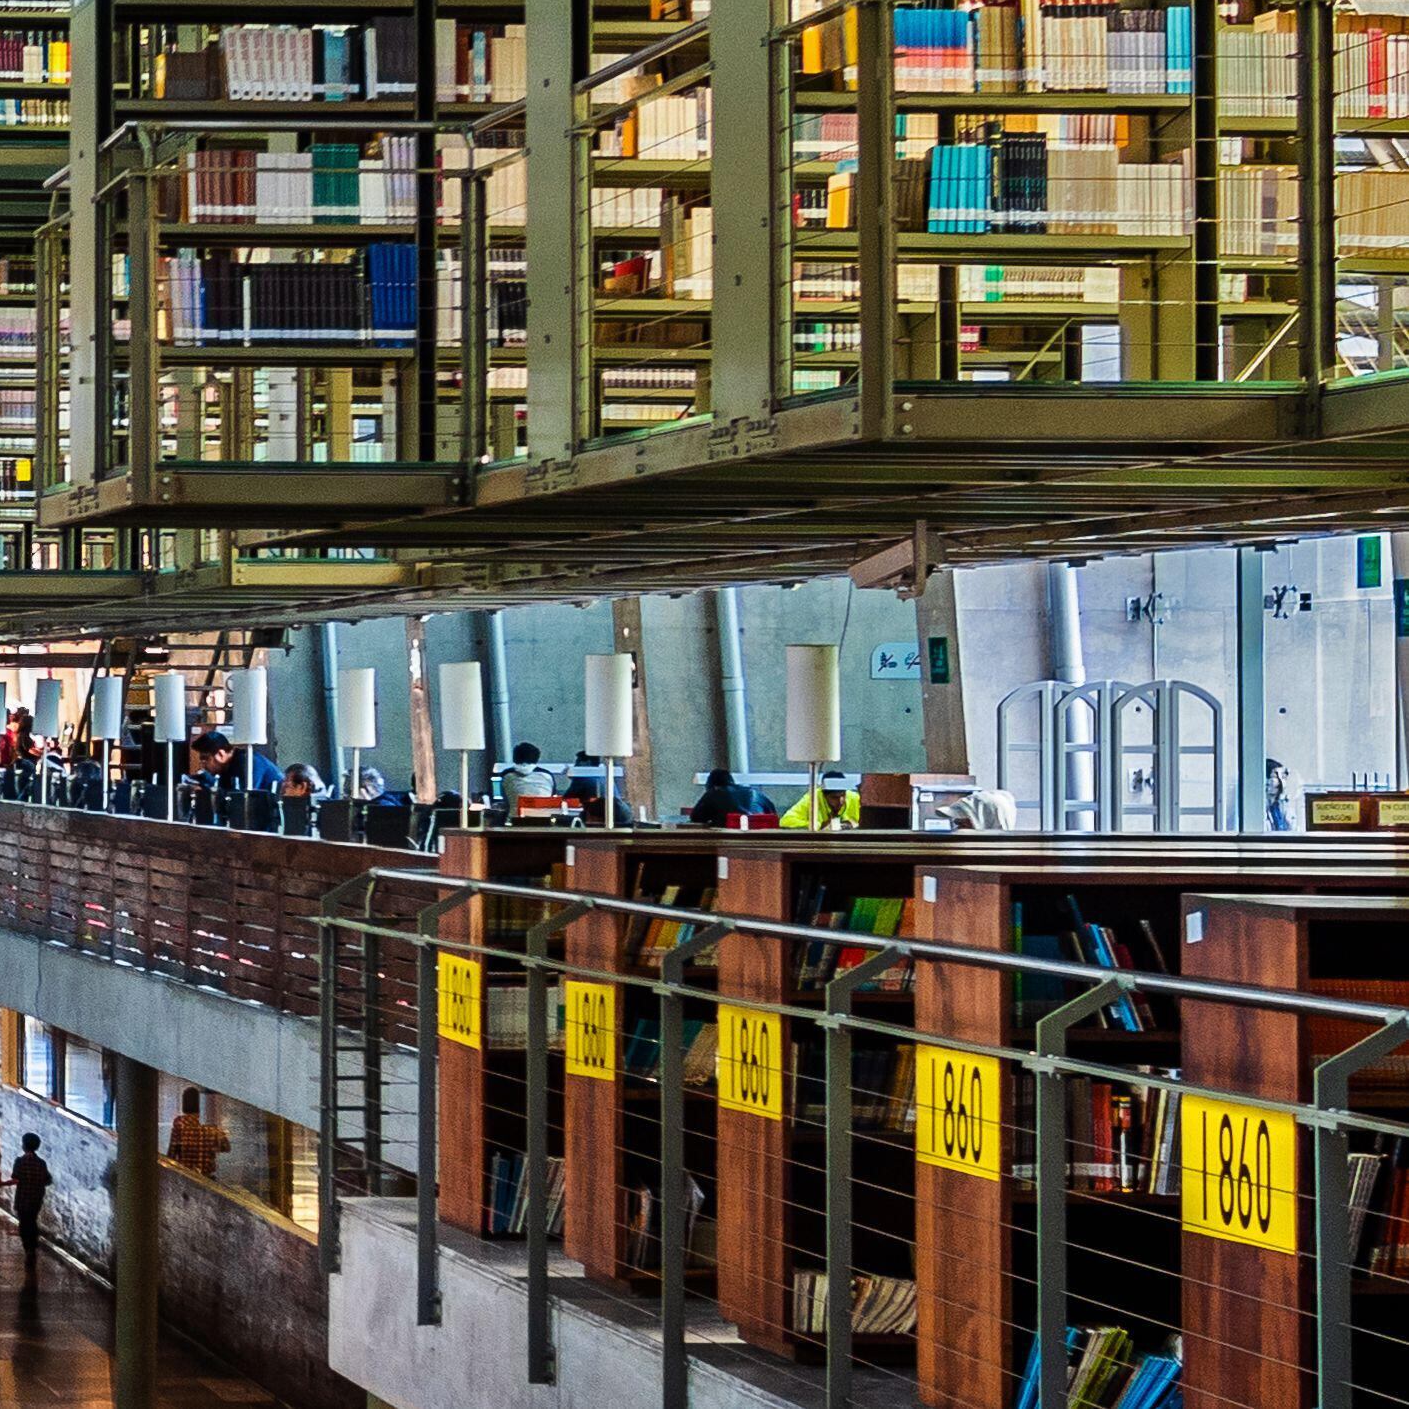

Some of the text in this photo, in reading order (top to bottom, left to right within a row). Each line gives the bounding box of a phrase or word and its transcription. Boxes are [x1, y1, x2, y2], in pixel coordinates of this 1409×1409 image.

[575, 991, 606, 1069] 1860
[731, 1015, 770, 1106] 1860
[931, 1058, 982, 1164] 1860
[1202, 1110, 1272, 1234] 1860
